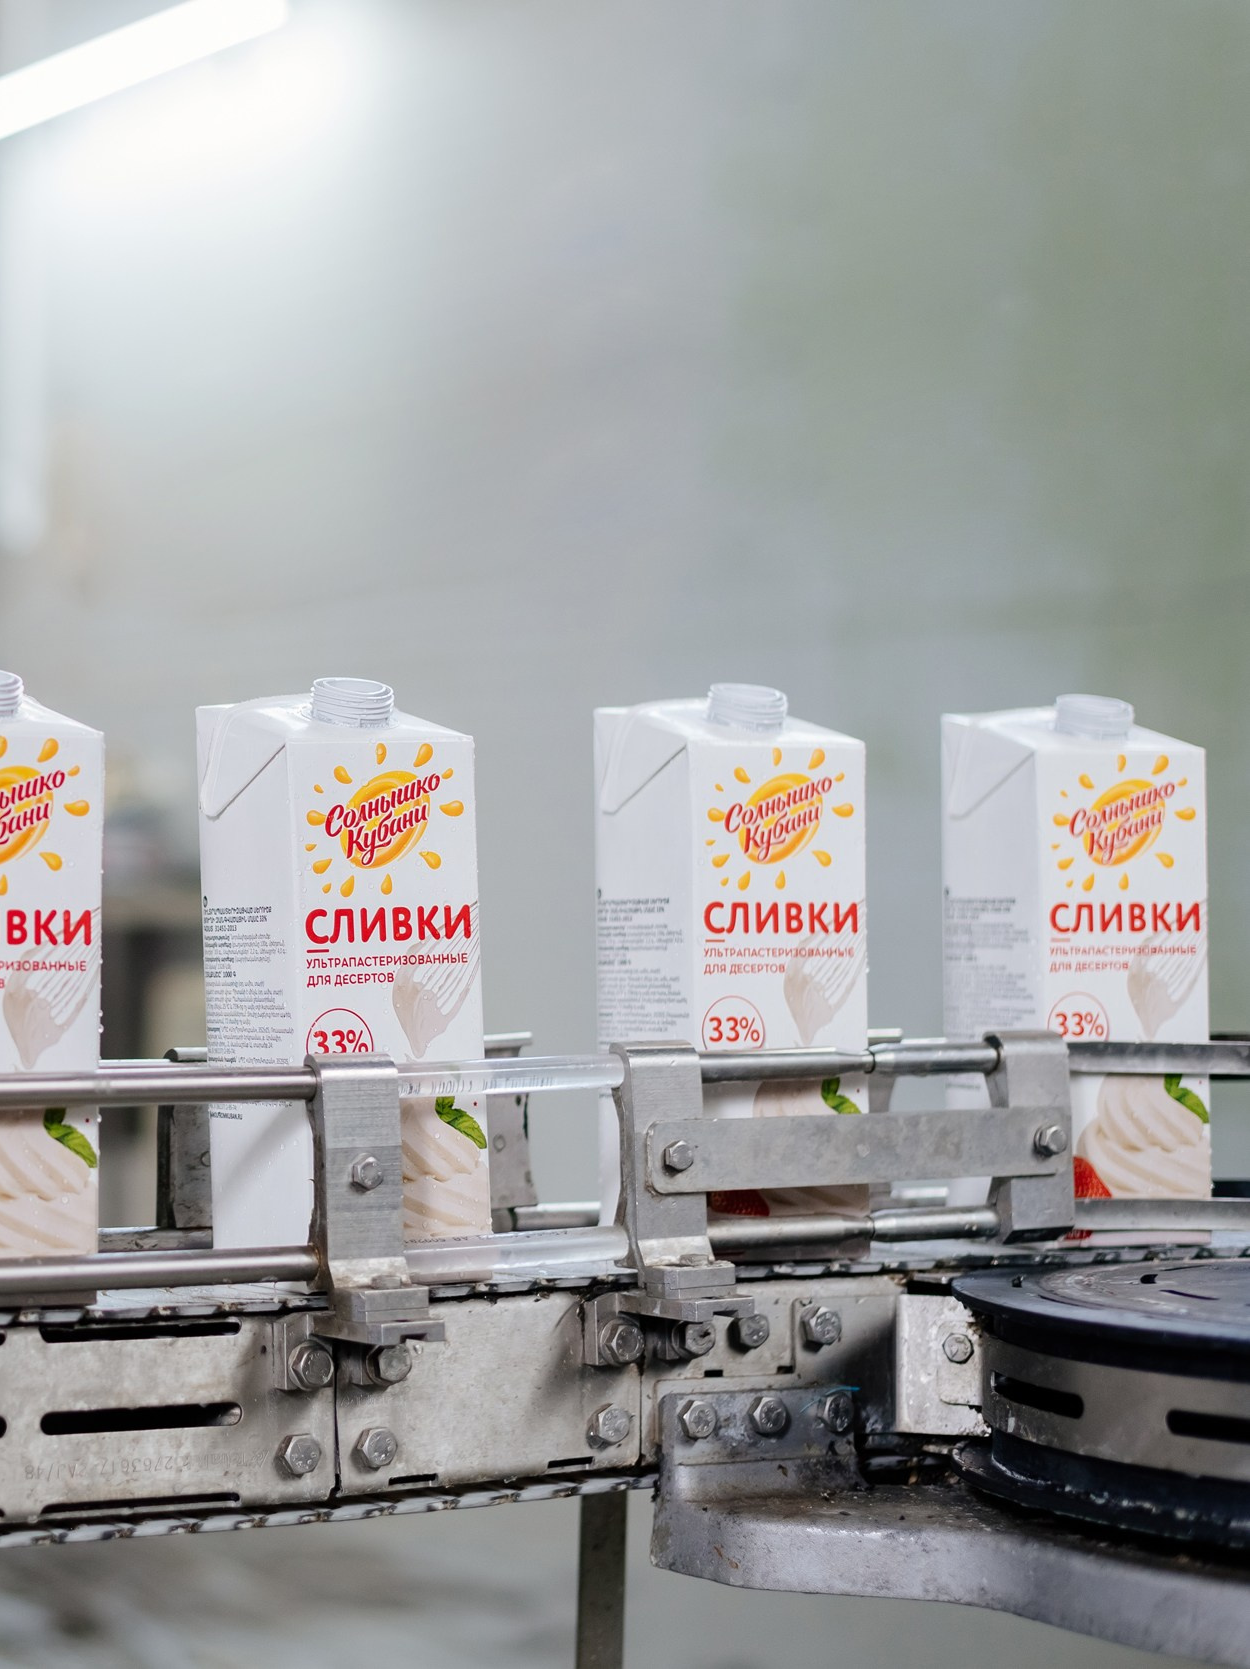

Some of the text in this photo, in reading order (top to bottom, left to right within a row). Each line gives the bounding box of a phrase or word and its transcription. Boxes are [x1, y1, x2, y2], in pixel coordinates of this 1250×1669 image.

[324, 773, 441, 838] Солнышко
[724, 776, 833, 832] Солнышко
[1068, 782, 1175, 837] Солнышко
[346, 803, 429, 866] Кубани
[744, 806, 820, 862] Кубани
[1087, 811, 1164, 864] Кубани
[305, 904, 472, 945] СЛИВКИ
[703, 901, 858, 934] СЛИВКИ
[1050, 902, 1200, 933] СЛИВКИ
[306, 950, 467, 969] УЛЬТРАПАСТЕРИЗОВАННЫЕ
[703, 947, 855, 959] УЛЬТРАПАСТЕРИЗОВАННЫЕ
[1049, 945, 1197, 957] УЛЬТРАПАСТЕРИЗОВАННЫЕ
[306, 971, 395, 987] ДЛЯ ДЕСЕРТОВ
[702, 962, 787, 976] ДЛЯ ДЕСЕРТОВ
[1049, 961, 1131, 974] ДЛЯ ДЕСЕРТОВ
[709, 1016, 760, 1043] 33%
[1056, 1012, 1103, 1037] 33%
[313, 1029, 369, 1054] 33%
